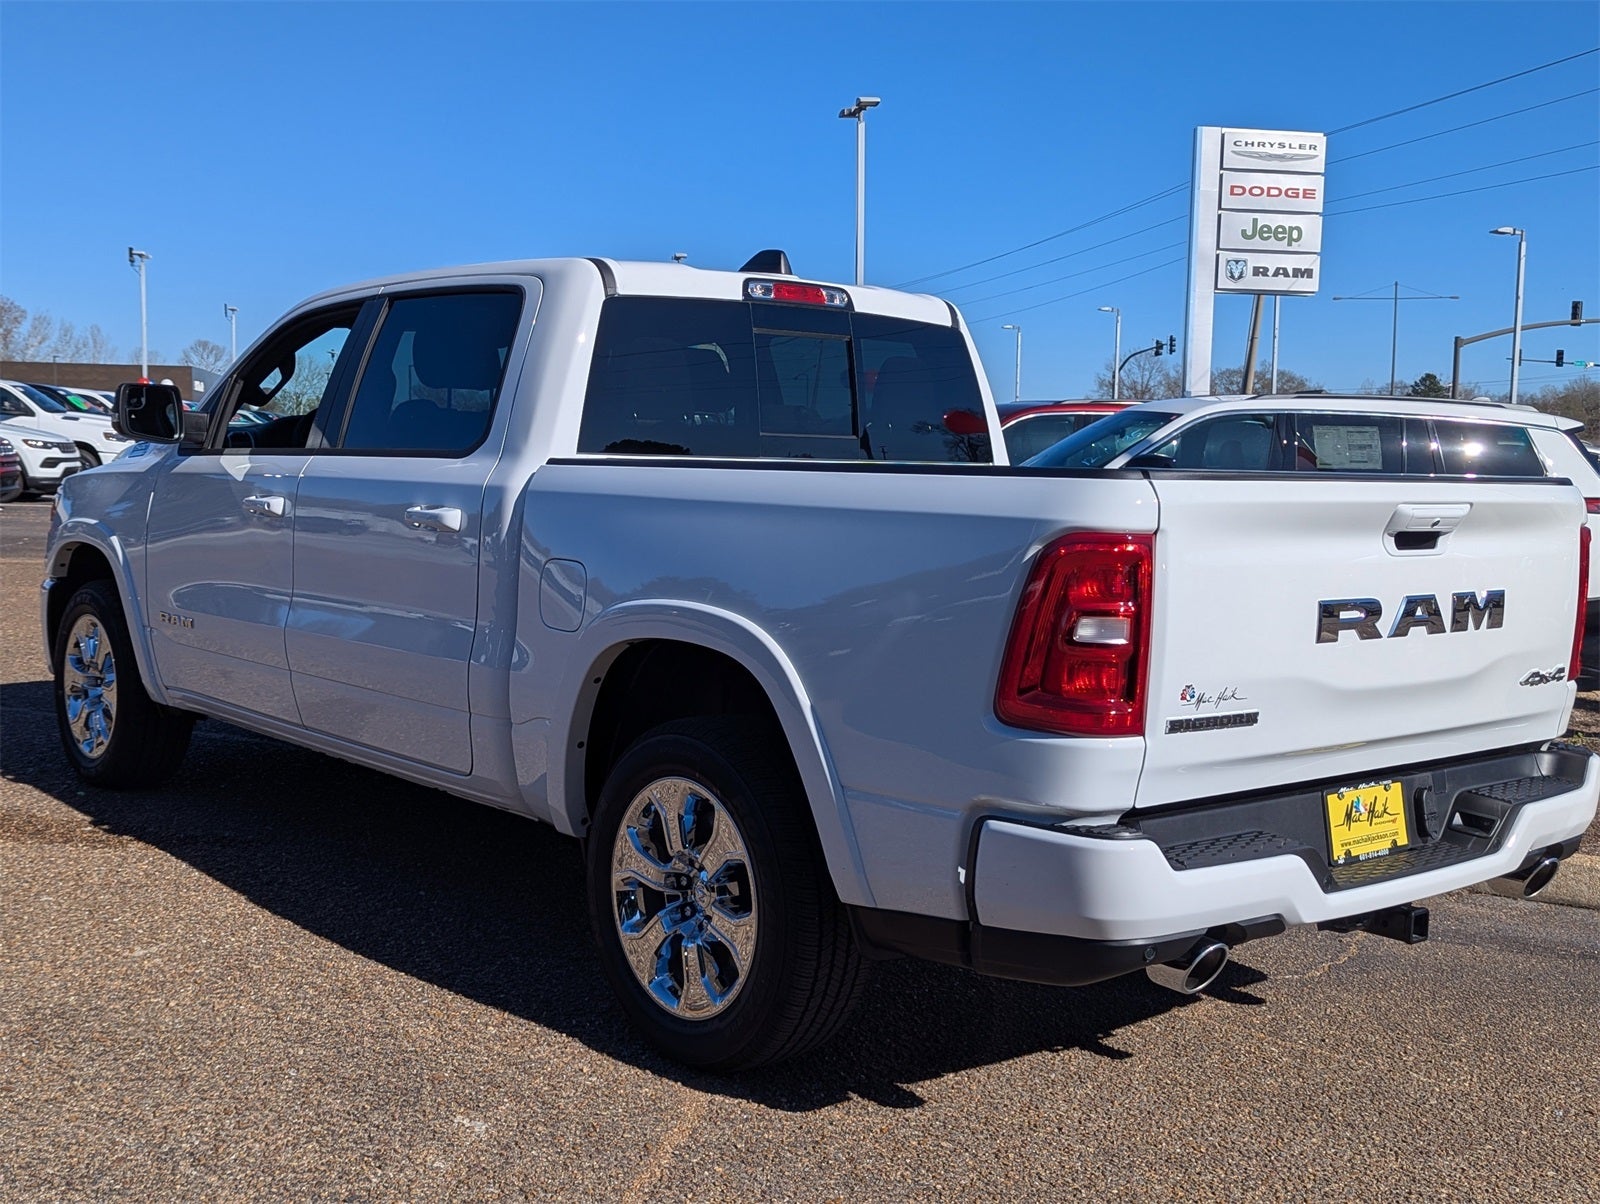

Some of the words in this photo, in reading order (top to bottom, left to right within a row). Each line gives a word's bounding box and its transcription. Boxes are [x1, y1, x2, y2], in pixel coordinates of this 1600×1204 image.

[1232, 140, 1318, 151] CHRYSLER
[1229, 184, 1317, 200] DODGE
[1240, 217, 1303, 247] Jeep
[1252, 266, 1314, 279] RAM
[160, 611, 194, 629] RAM
[1315, 589, 1506, 644] RAM
[1187, 692, 1214, 711] Mac
[1335, 799, 1366, 831] Mac
[1367, 795, 1400, 827] Haik
